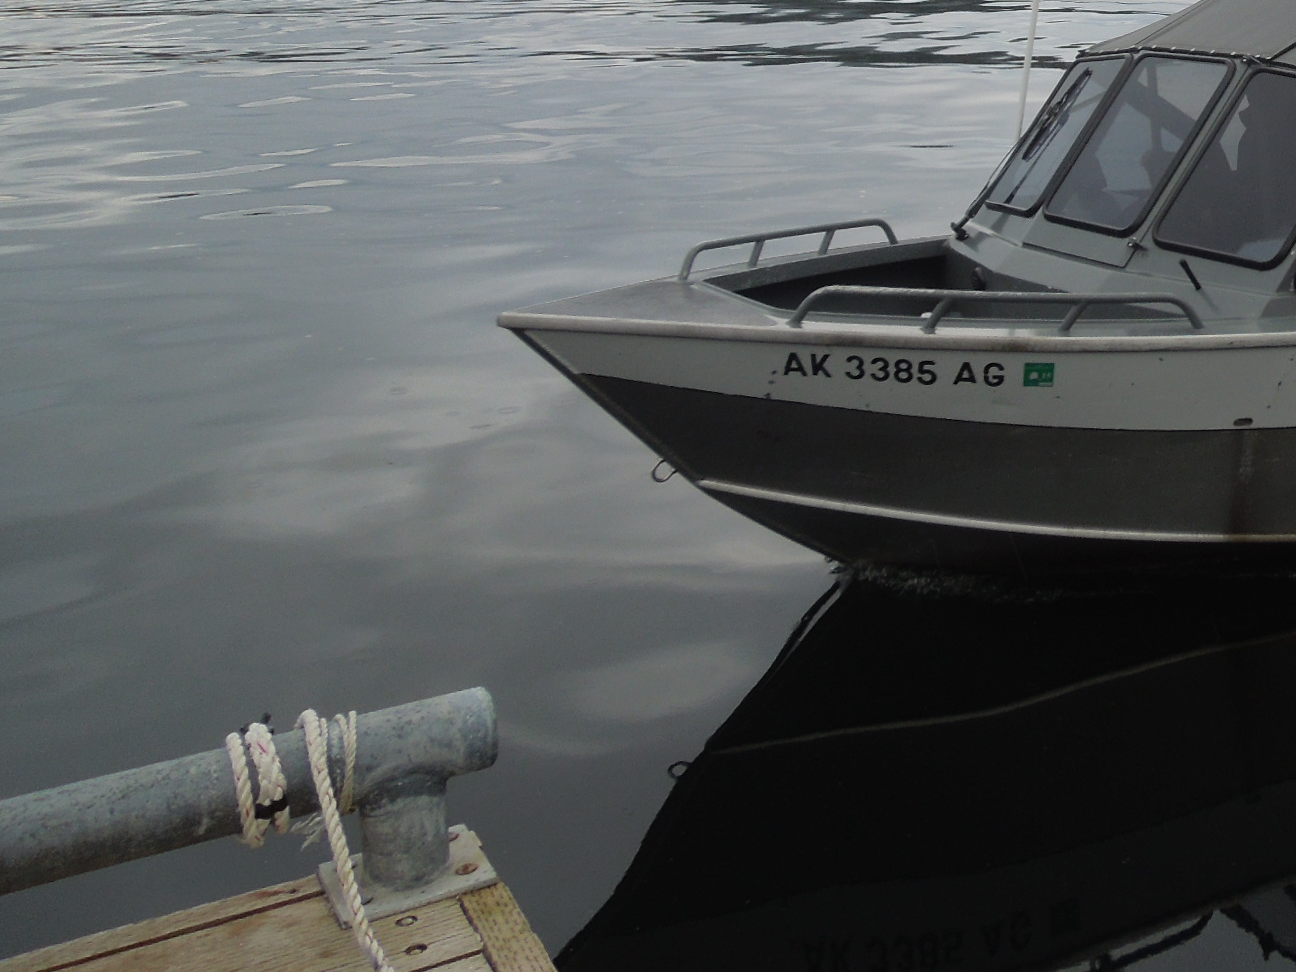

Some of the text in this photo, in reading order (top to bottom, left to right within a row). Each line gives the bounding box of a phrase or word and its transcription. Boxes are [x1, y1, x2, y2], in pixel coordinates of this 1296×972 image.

[783, 352, 832, 378] AK
[845, 355, 938, 386] 3385
[952, 362, 1006, 387] AG
